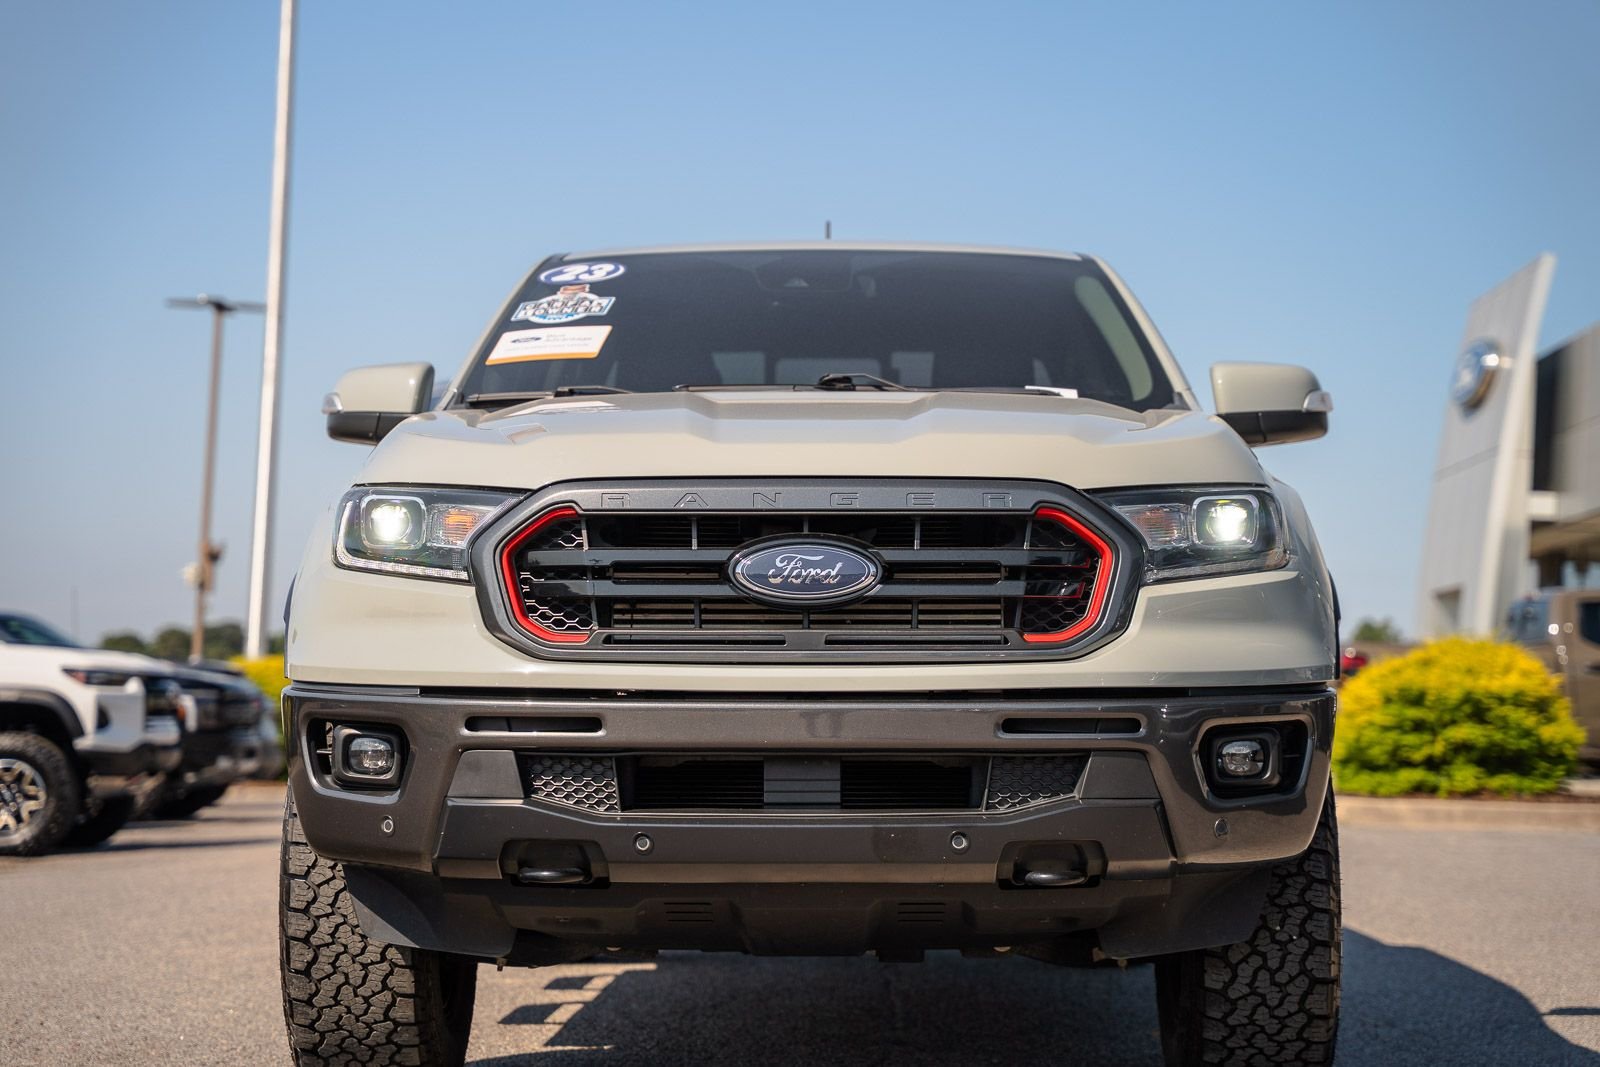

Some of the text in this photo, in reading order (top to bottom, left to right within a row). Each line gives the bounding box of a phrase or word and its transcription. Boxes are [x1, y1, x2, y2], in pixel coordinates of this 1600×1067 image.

[551, 263, 616, 282] 23
[600, 492, 1013, 508] RANGER
[767, 553, 844, 585] Ford
